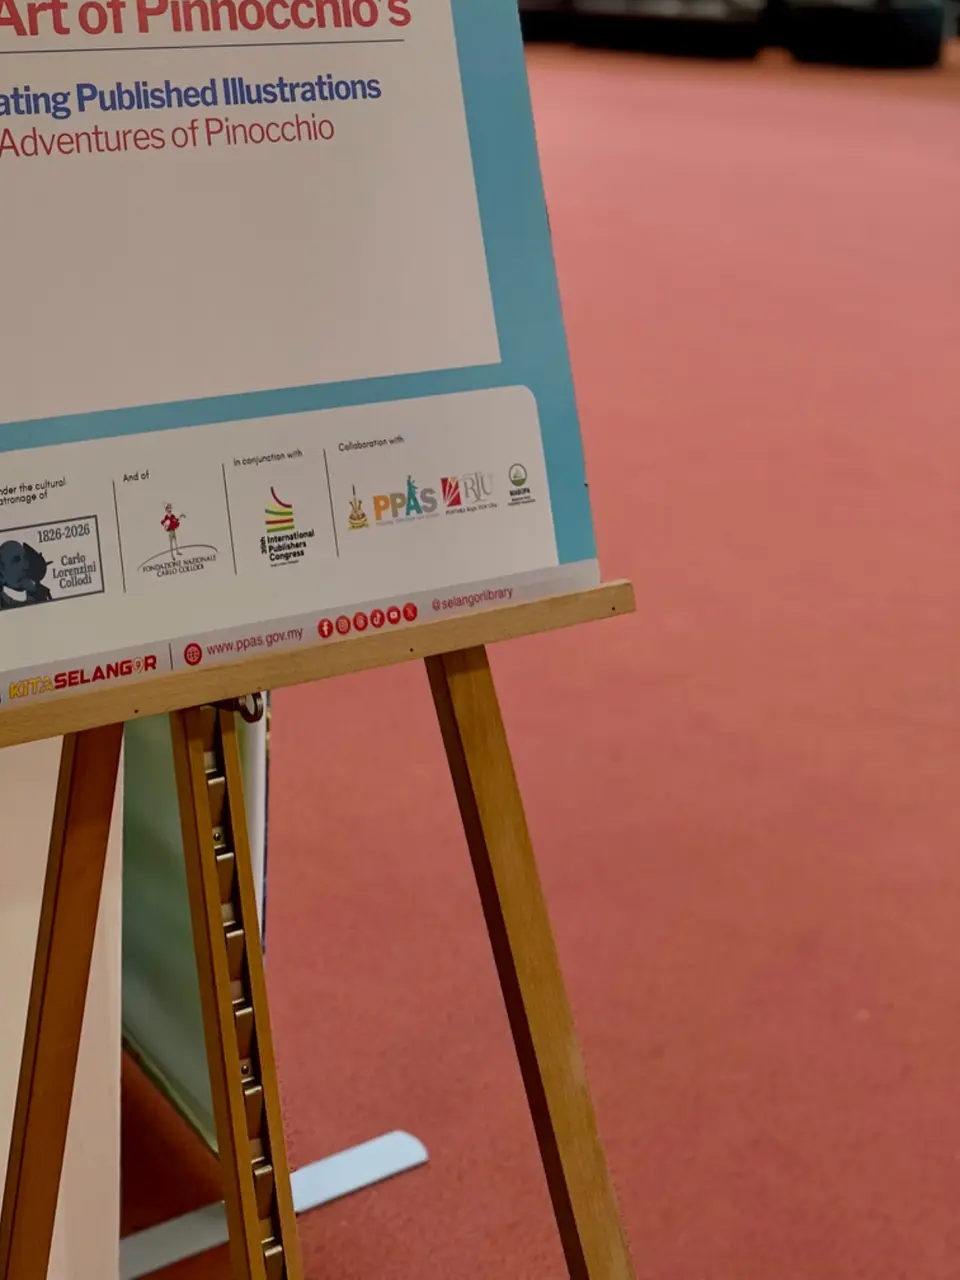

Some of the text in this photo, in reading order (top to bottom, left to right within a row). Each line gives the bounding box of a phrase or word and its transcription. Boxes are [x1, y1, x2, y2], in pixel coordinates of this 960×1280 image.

[77, 78, 218, 112] Published
[222, 73, 382, 105] Illustrations
[171, 117, 200, 149] of
[206, 113, 335, 147] Pinocchio
[338, 434, 404, 451] Collaboration with
[242, 452, 285, 467] conjunction
[287, 449, 303, 459] with
[19, 482, 32, 493] the
[34, 477, 66, 491] cultural
[122, 470, 150, 483] And of
[39, 490, 49, 500] of
[373, 476, 437, 521] PPAS
[37, 523, 91, 543] 1826-2026
[267, 528, 315, 544] International
[268, 540, 307, 553] Publishers
[60, 553, 87, 569] Carlo
[269, 549, 304, 562] Congress
[52, 562, 96, 579] Lorenzini
[59, 573, 93, 590] Collodi
[432, 586, 514, 612] @selangorlibrary
[206, 626, 305, 657] www.ppas.gov.my
